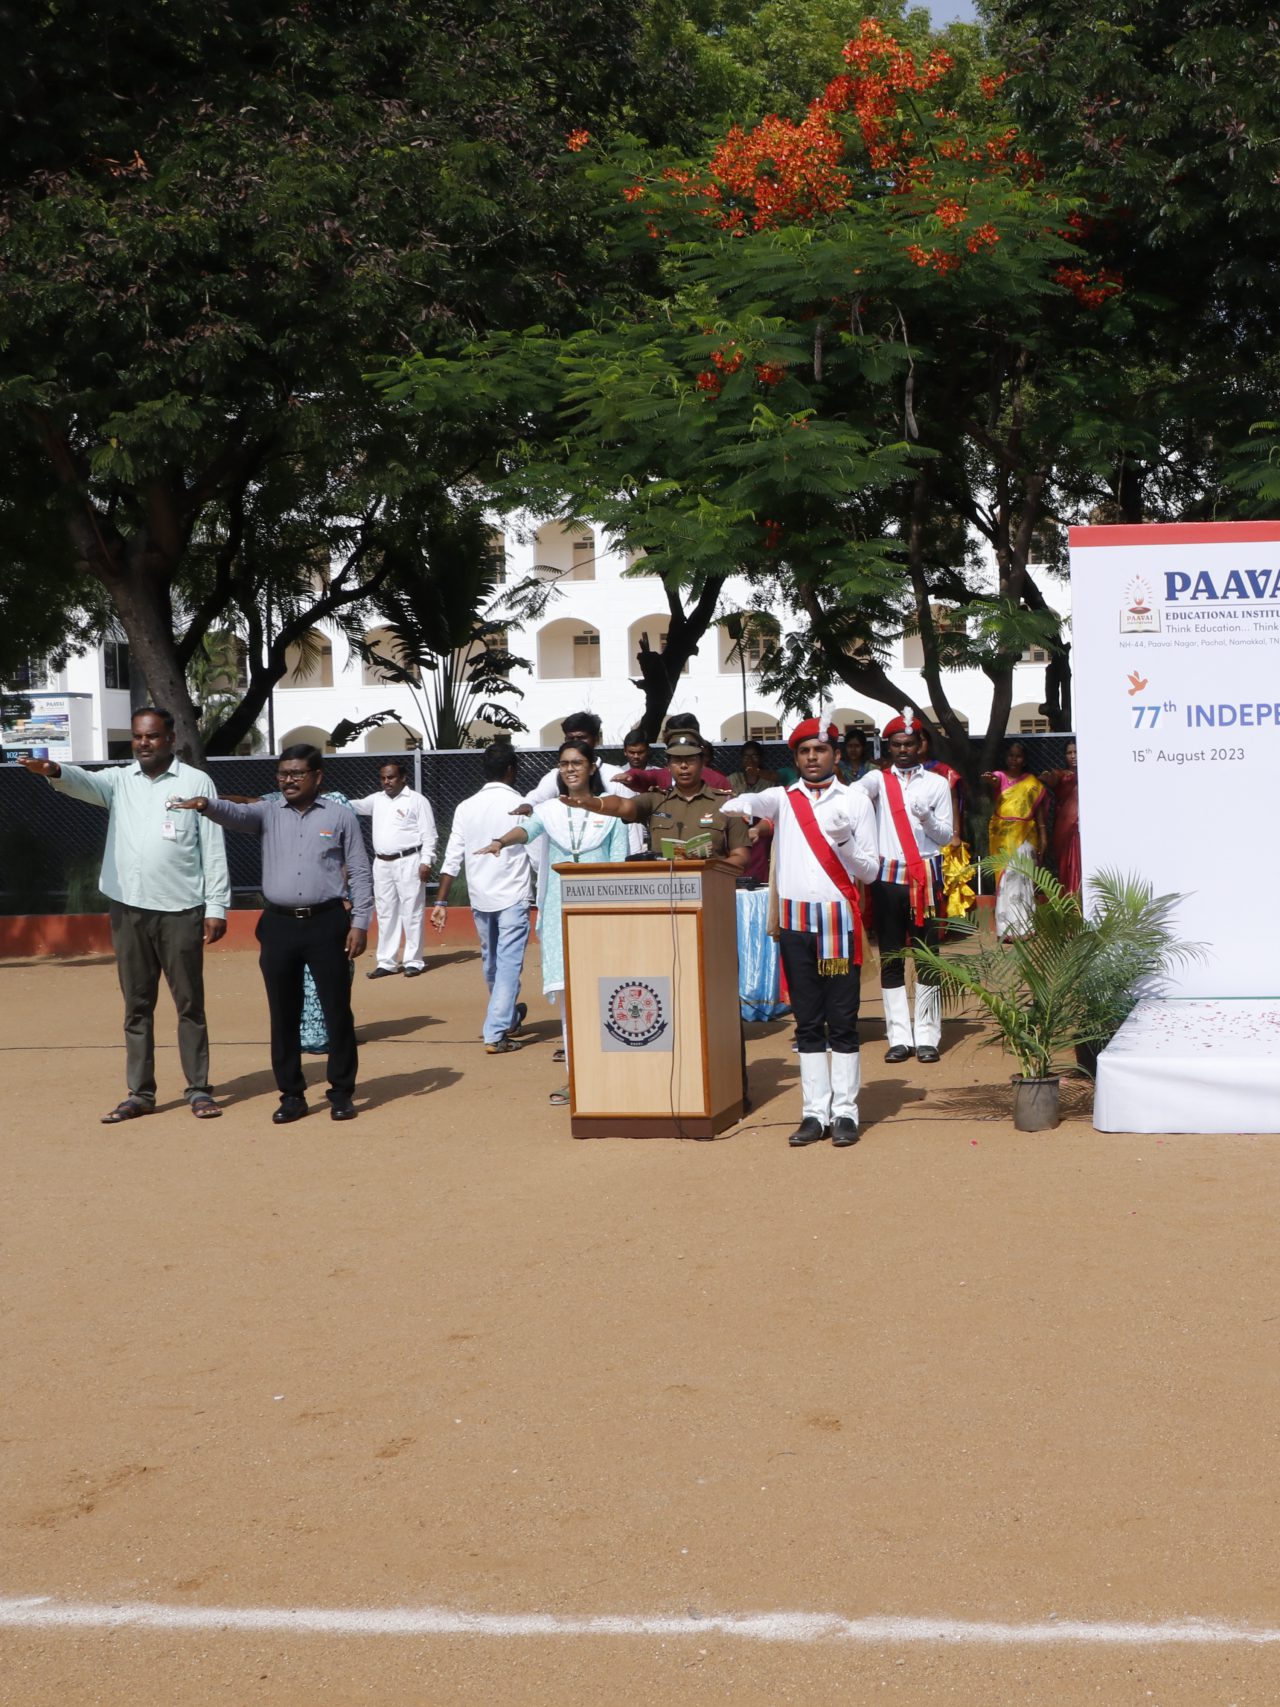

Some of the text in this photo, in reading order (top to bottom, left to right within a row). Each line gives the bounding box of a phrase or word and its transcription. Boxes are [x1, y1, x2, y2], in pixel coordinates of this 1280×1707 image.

[1165, 610, 1239, 620] EDUCATIONAL
[1166, 624, 1192, 633] Think
[1253, 621, 1280, 631] Think
[1156, 748, 1206, 765] August
[1210, 747, 1245, 762] 2023
[566, 882, 697, 897] PAAVAI ENGINEERING COLLEGE
